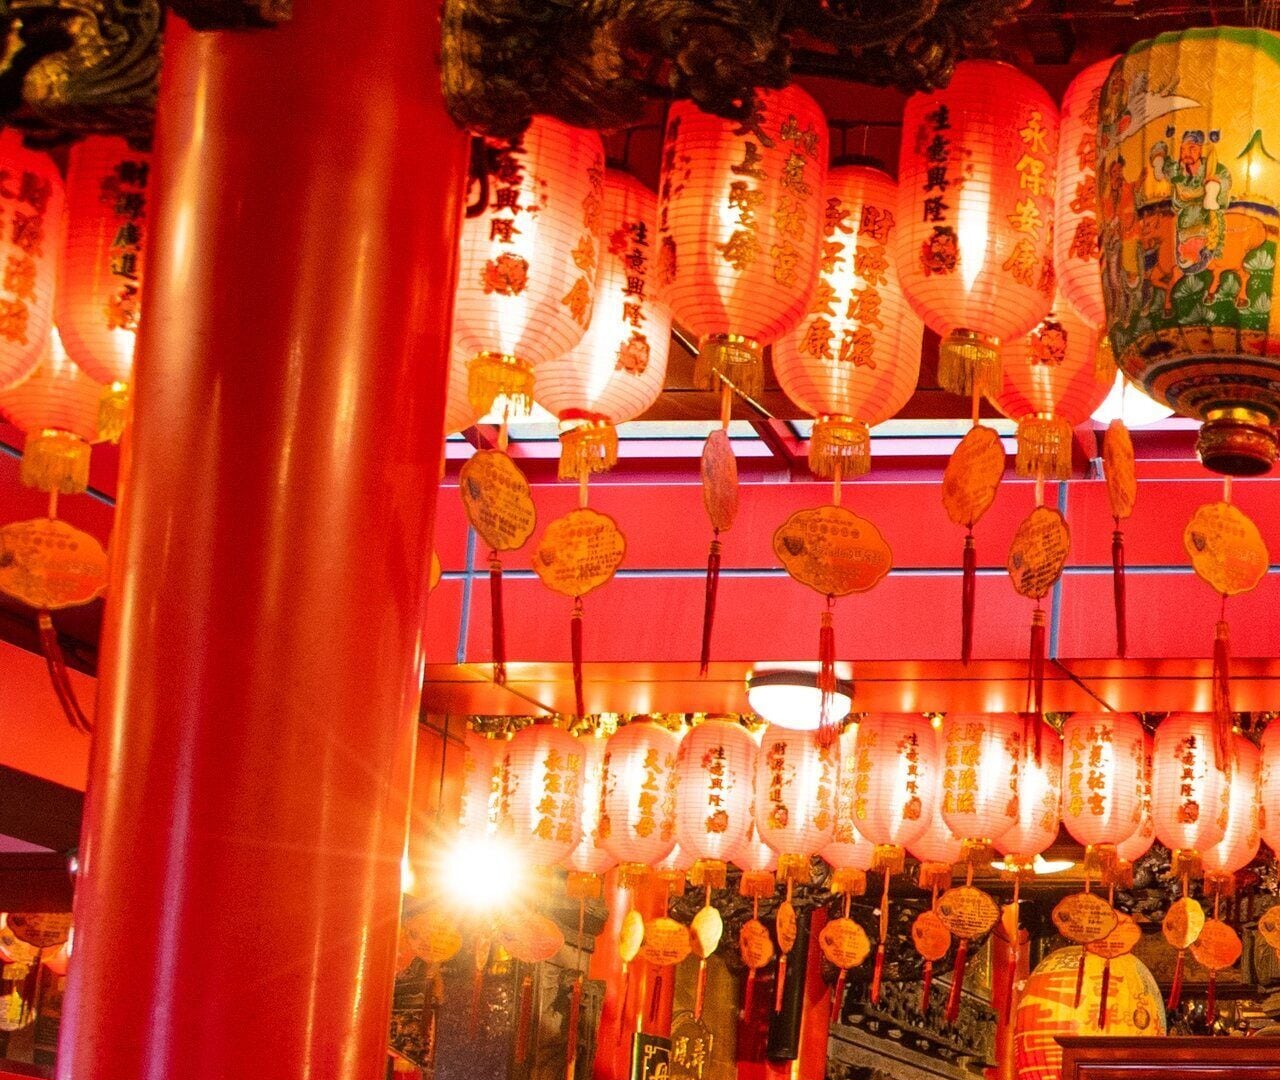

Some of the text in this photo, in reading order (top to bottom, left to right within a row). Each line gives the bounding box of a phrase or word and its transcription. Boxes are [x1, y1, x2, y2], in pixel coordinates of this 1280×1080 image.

[924, 103, 949, 222] 生意興隆
[1002, 111, 1048, 286] 永保安康
[622, 221, 650, 329] 生意興隆
[1179, 735, 1197, 797] 生意興隆
